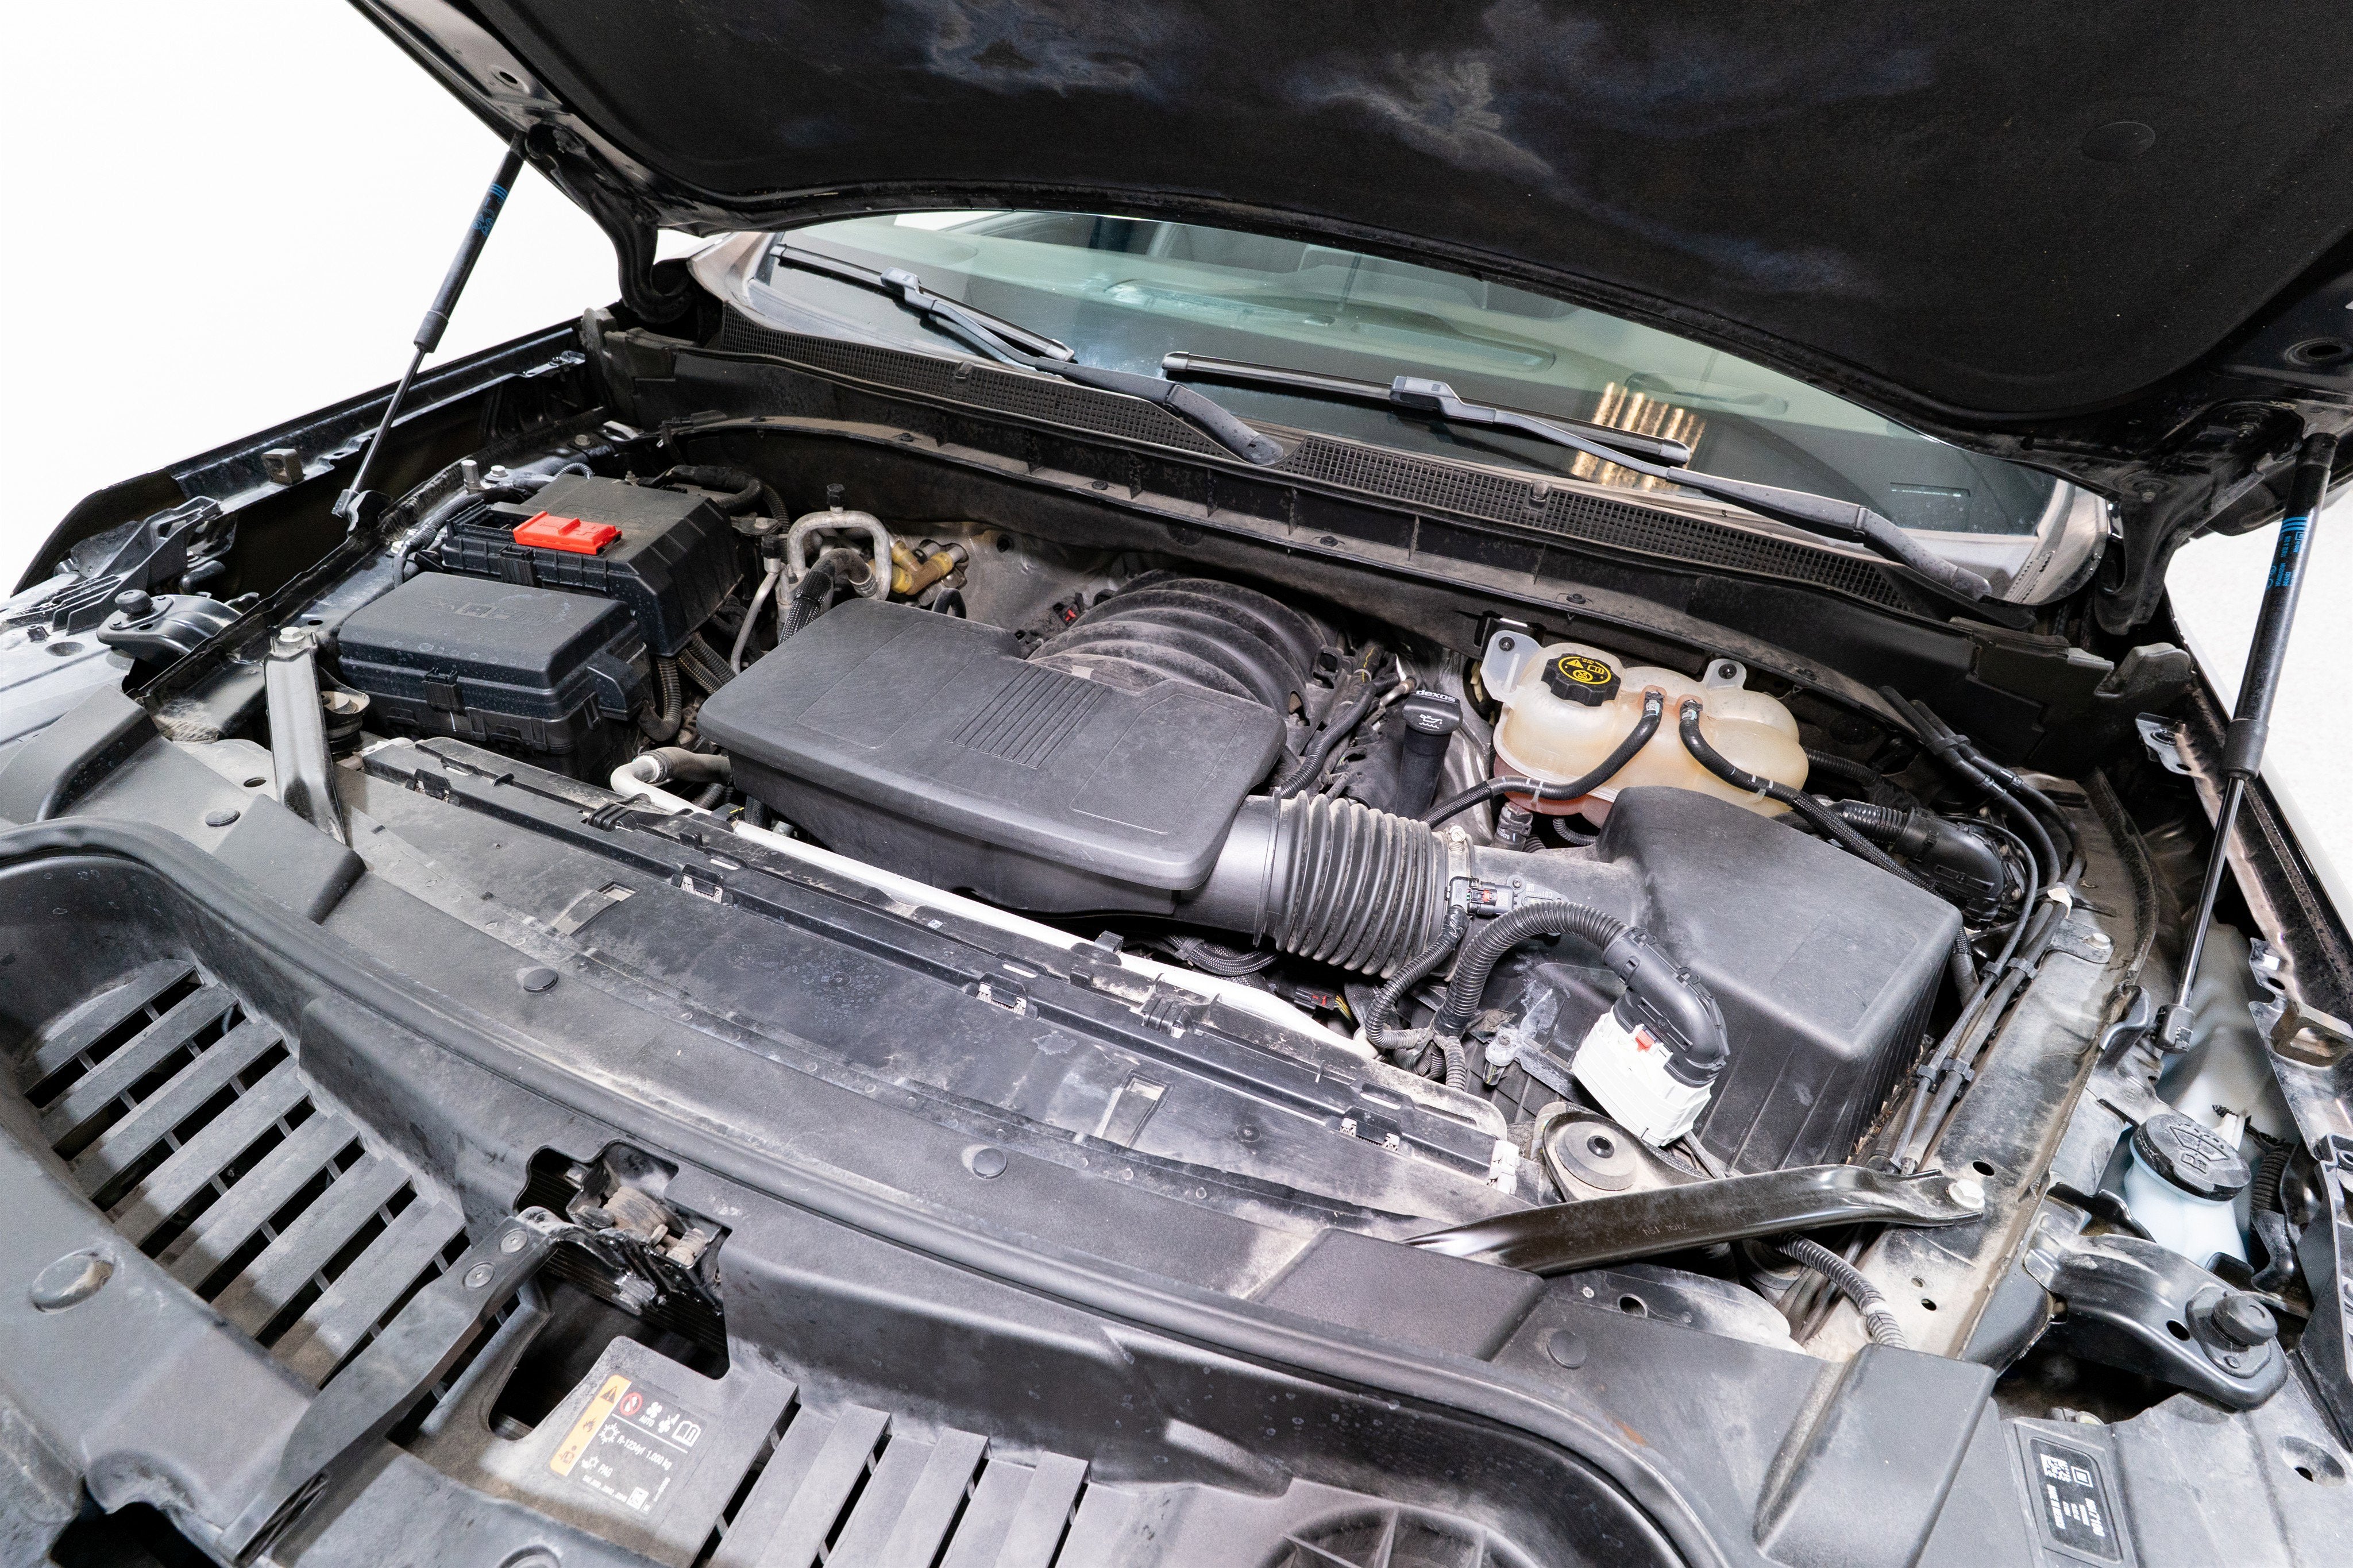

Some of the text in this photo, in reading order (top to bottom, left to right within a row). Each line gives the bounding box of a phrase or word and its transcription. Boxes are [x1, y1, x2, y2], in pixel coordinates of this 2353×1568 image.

[1416, 690, 1456, 702] dexos
[639, 1415, 655, 1427] AUTO
[616, 1435, 672, 1470] R-1234yf 1.000 kg
[597, 1463, 614, 1478] PAG
